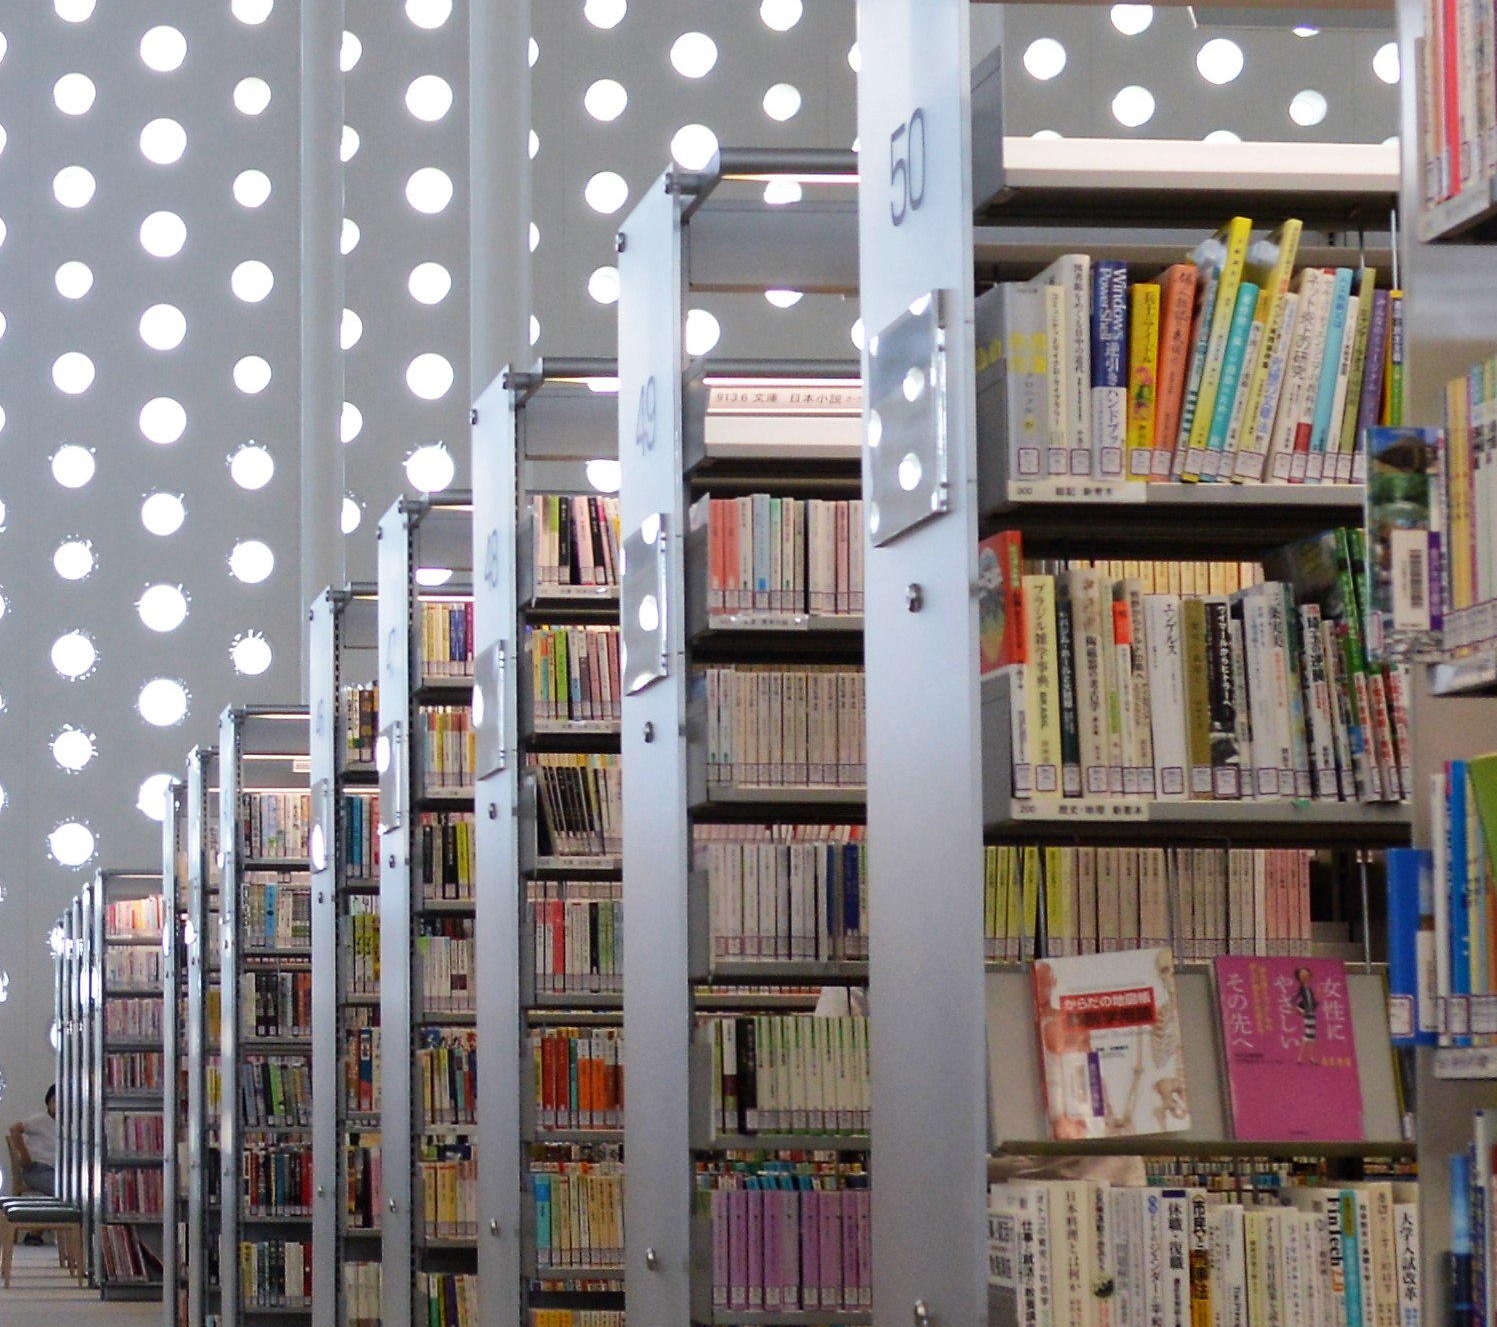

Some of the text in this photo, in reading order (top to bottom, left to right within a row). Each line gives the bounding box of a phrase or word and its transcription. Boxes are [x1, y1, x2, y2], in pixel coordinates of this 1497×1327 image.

[889, 107, 927, 227] 50
[635, 373, 657, 457] 49
[753, 392, 778, 404] 文庫
[789, 392, 842, 405] 日本小説
[1162, 602, 1178, 657] エンゲルス
[1224, 974, 1254, 1050] その先へ
[1272, 975, 1301, 1051] やさしい
[1321, 977, 1347, 1041] 女性に
[1065, 1190, 1081, 1293] 日本料理とは何か
[1169, 1202, 1185, 1270] 休職・復職
[1326, 1197, 1345, 1268] FinTech
[1400, 1212, 1420, 1302] 大学入試改革
